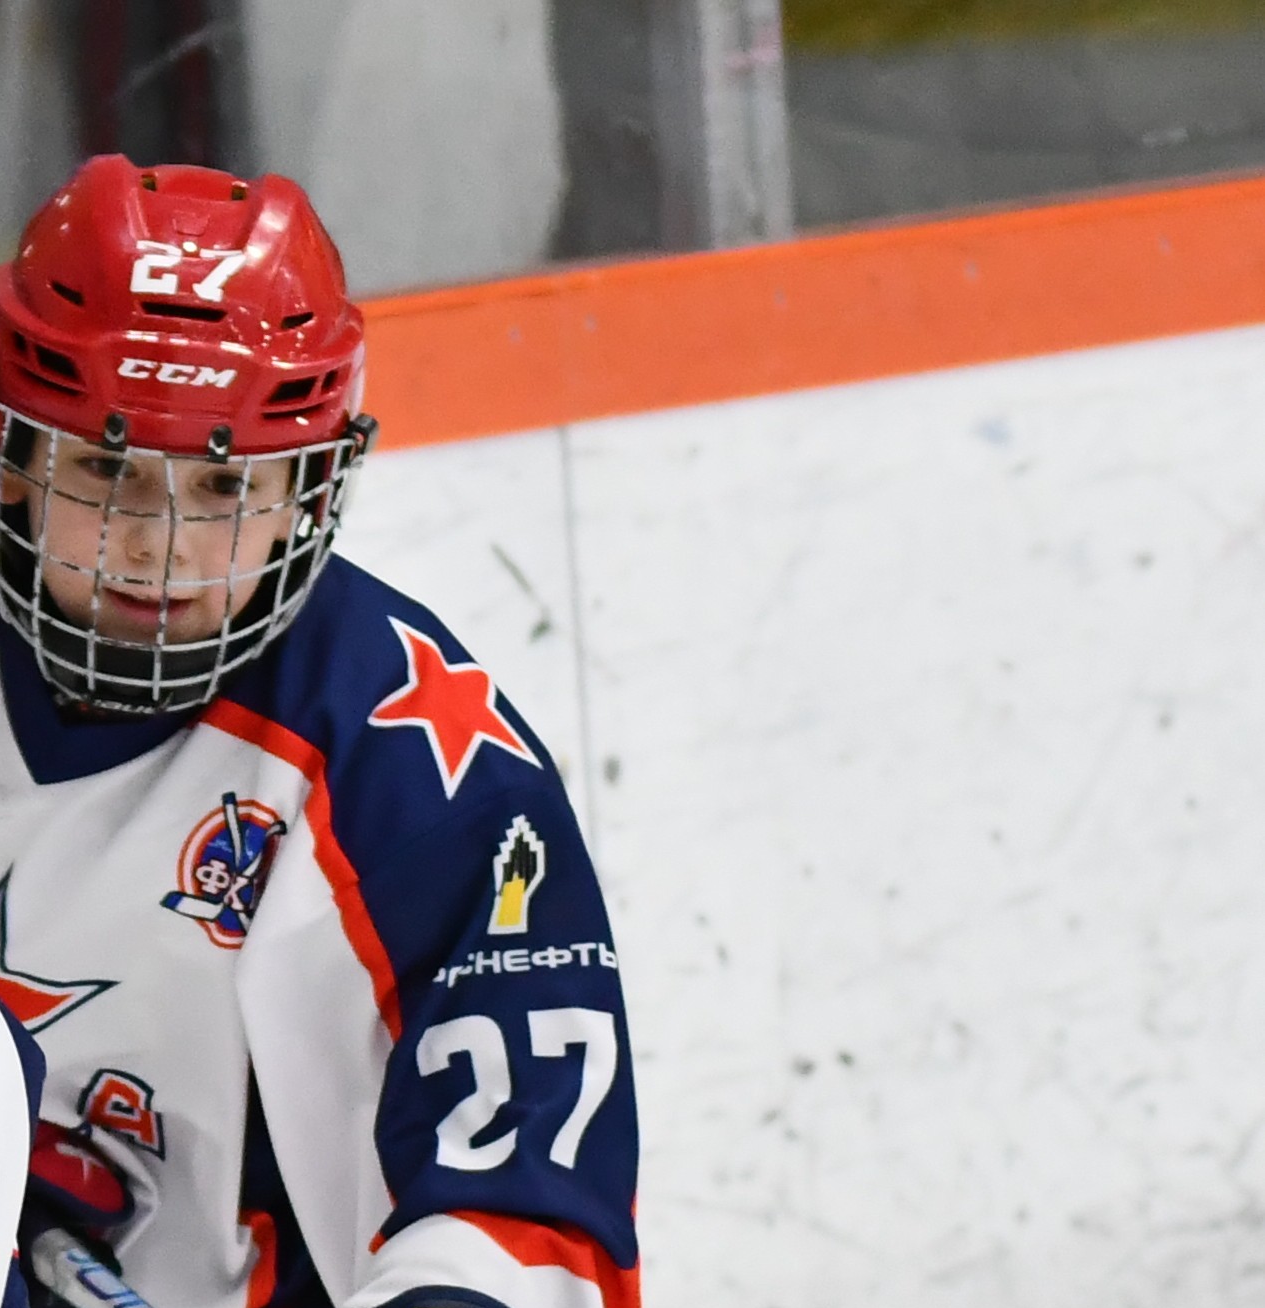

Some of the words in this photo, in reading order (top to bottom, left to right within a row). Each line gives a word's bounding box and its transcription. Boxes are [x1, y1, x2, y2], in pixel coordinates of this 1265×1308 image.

[130, 240, 247, 302] 27
[117, 357, 238, 389] CCM
[415, 1007, 619, 1171] 27
